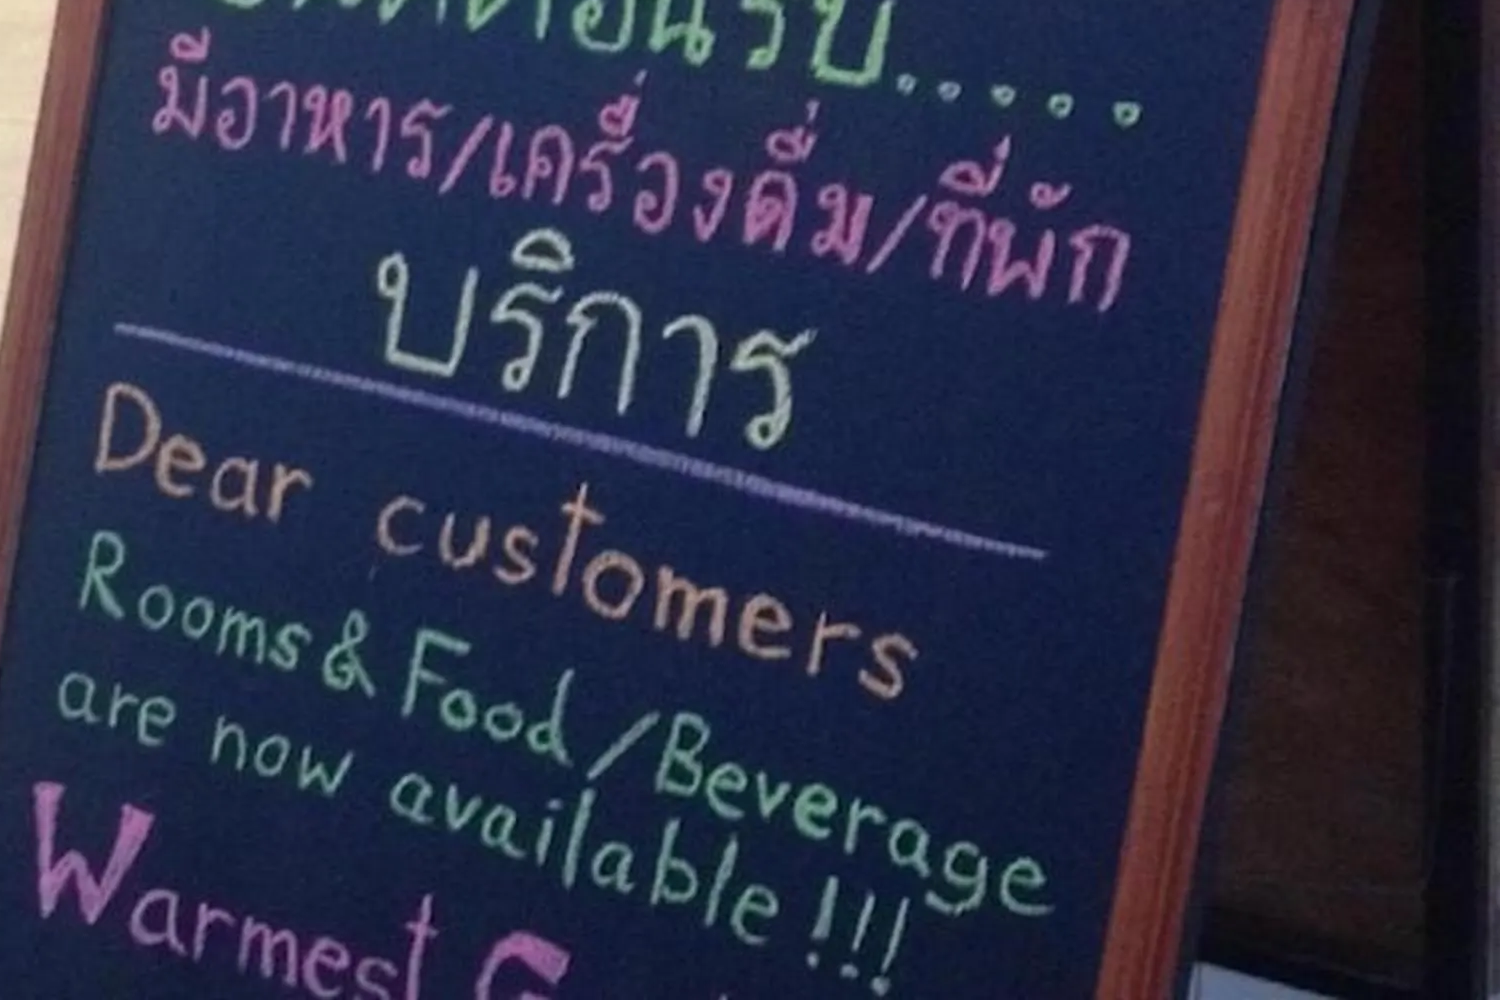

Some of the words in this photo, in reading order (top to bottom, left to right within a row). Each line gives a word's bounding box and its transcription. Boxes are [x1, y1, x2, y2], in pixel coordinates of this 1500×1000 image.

[375, 227, 817, 450] บริการ
[94, 382, 315, 522] Dear
[375, 483, 920, 702] customers
[58, 669, 177, 748] are
[209, 709, 355, 798] now
[32, 780, 440, 1000] Warmest
